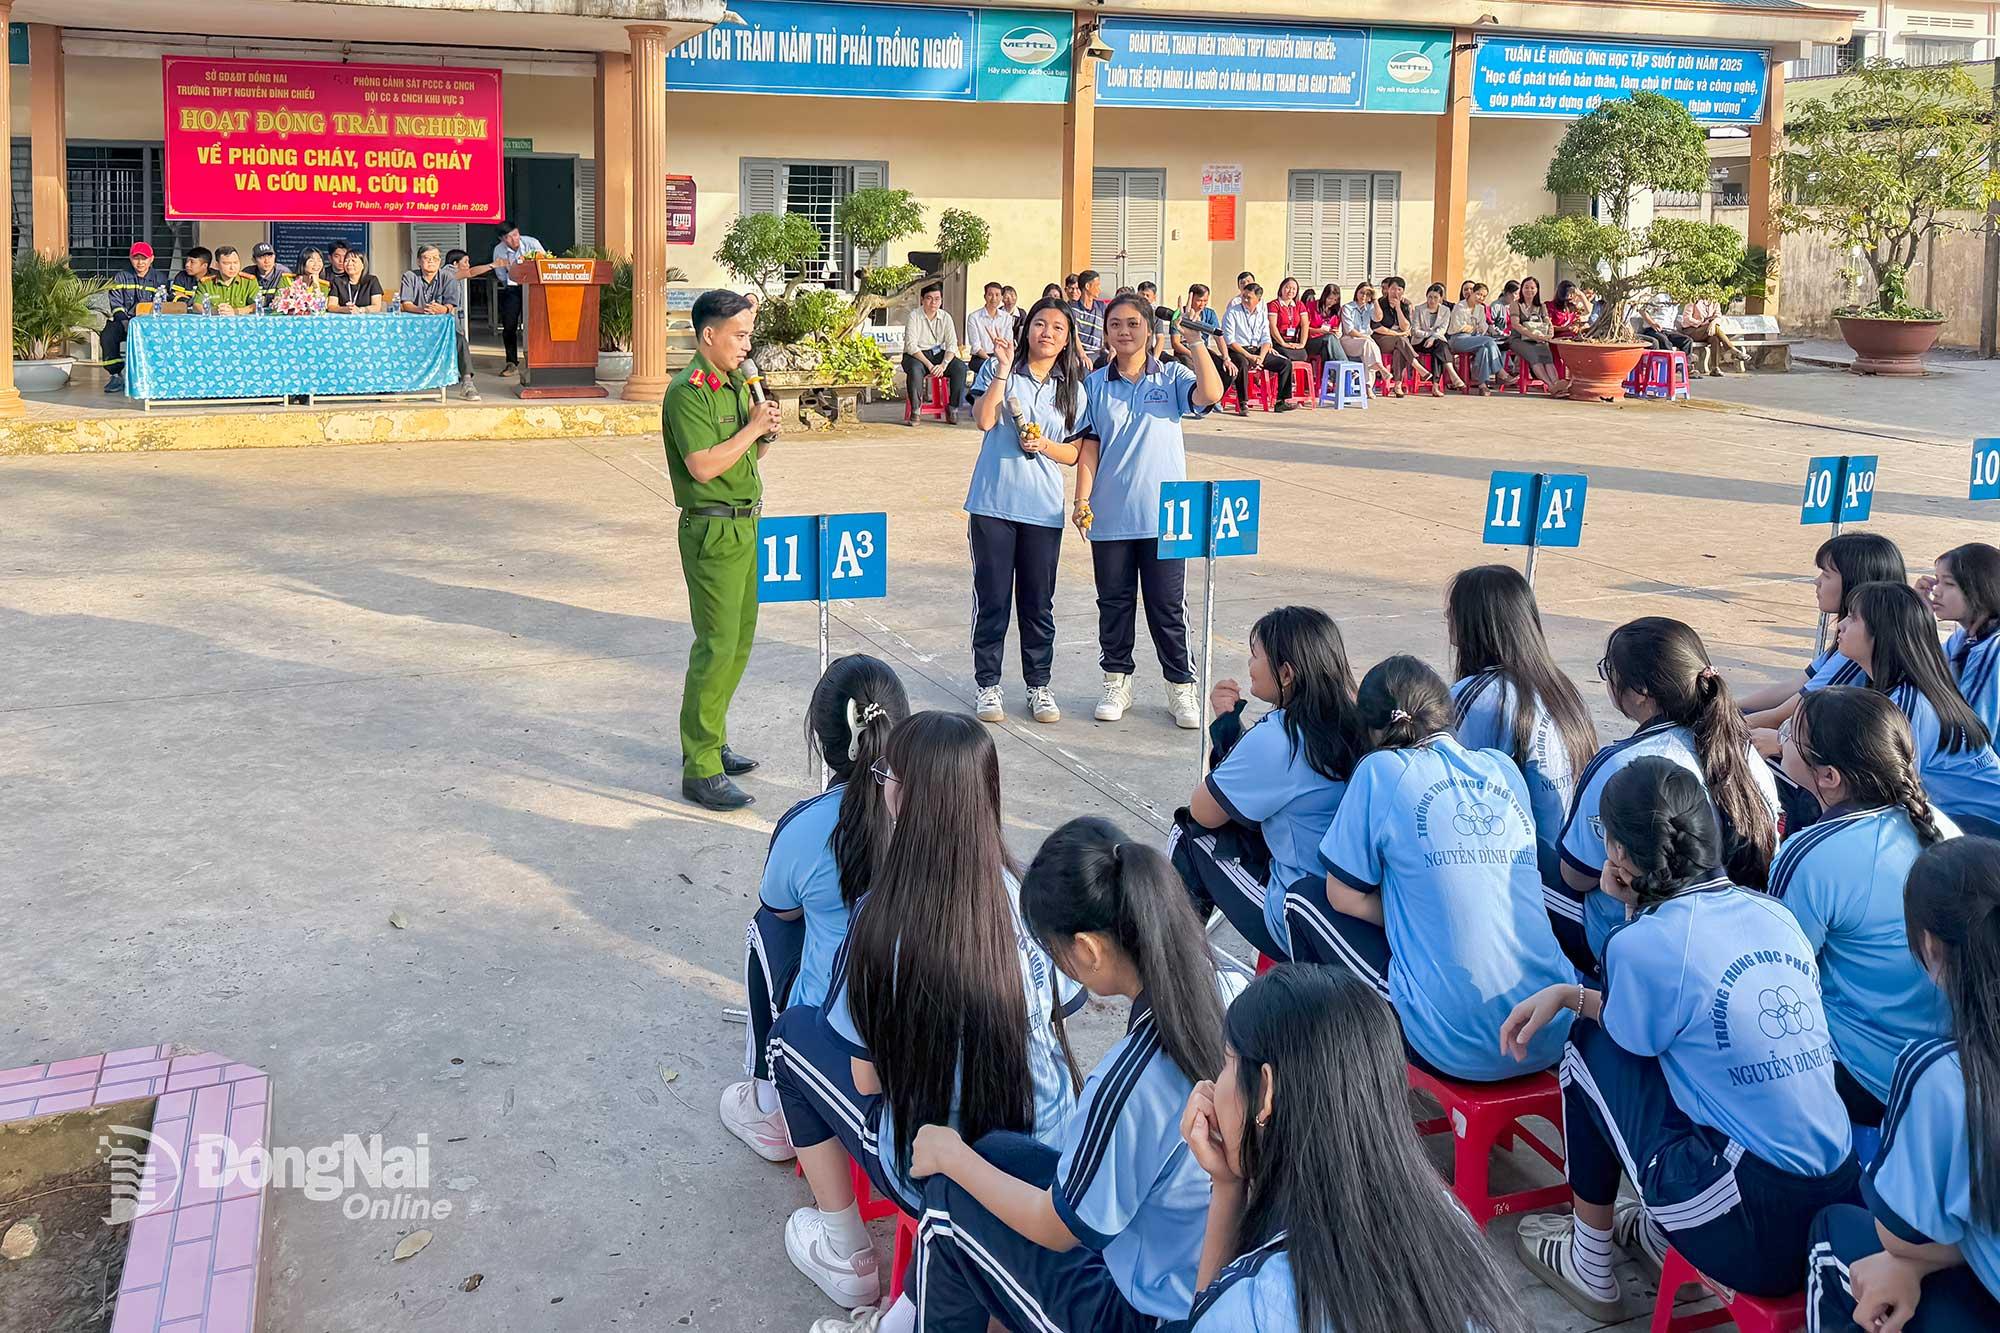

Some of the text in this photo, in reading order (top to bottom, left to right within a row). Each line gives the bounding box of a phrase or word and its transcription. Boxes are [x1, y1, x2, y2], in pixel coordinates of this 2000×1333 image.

[735, 24, 775, 62] TRĂM
[779, 25, 812, 64] NĂM
[816, 27, 836, 65] THÌ
[840, 25, 872, 66] PHẢI
[876, 26, 920, 68] TRỒNG
[922, 32, 964, 70] NGƯỜI
[1129, 30, 1150, 53] ĐOÀN
[1152, 31, 1170, 56] VIÊN,
[1172, 36, 1196, 55] THANH
[1198, 33, 1217, 56] NIÊN
[1217, 33, 1245, 56] TRƯỜNG
[1247, 38, 1265, 58] THPT
[1265, 34, 1294, 58] NGUYỄN
[1295, 37, 1313, 59] ĐÌNH
[1505, 44, 1743, 72] TUẦN LỄ HƯỞNG ỨNG HỌC TẬP SUỐT ĐỜI NĂM 2025
[205, 69, 216, 81] SỞ
[248, 70, 270, 83] ĐỒNG
[273, 74, 288, 84] NAI
[354, 75, 475, 91] PHÒNG CẢNH SÁT PCCC & CNCH
[1144, 66, 1161, 92] HIỆN
[1162, 66, 1183, 89] MÌNH
[1184, 67, 1194, 89] LÀ
[1195, 67, 1218, 90] NGƯỜI
[1219, 68, 1229, 90] CÓ
[1231, 69, 1246, 91] VĂN
[1246, 69, 1261, 91] HÓA
[1262, 73, 1276, 91] KHI
[1276, 74, 1296, 92] THAM
[1297, 75, 1309, 92] GIA
[1311, 75, 1327, 93] GIAO
[1523, 72, 1546, 86] phát
[1548, 70, 1571, 86] triển
[1574, 72, 1591, 87] bản
[1594, 74, 1618, 90] thân,
[1621, 75, 1639, 89] làm
[1641, 76, 1659, 90] chủ
[1674, 78, 1694, 90] thức
[1696, 79, 1707, 91] và
[1710, 80, 1731, 93] công
[1734, 80, 1758, 95] nghệ,
[177, 84, 210, 96] TRƯỜNG
[212, 87, 232, 97] THPT
[234, 86, 267, 98] NGUYỄN
[270, 87, 288, 98] ĐÌNH
[365, 92, 464, 106] ĐỘI CC & CNCH KHU VỰC 3
[1490, 92, 1508, 107] góp
[1511, 92, 1536, 108] phần
[1539, 96, 1557, 109] xây
[1559, 96, 1583, 111] dựng
[1688, 100, 1711, 116] thịnh
[180, 106, 487, 144] HOẠT ĐỘNG TRẢI NGHIỆM
[197, 142, 472, 170] VỀ PHÒNG CHÁY, CHỮA CHÁY
[234, 170, 439, 198] VÀ CỨU NẠN, CỨU HỘ
[332, 200, 352, 212] Long
[355, 200, 382, 210] Thành,
[384, 202, 404, 212] ngày
[406, 202, 415, 210] 17
[416, 202, 438, 212] tháng
[452, 204, 468, 212] năm
[470, 204, 488, 212] 2026
[1973, 450, 2000, 486] 10
[1804, 469, 1832, 508] 10
[1162, 499, 1193, 541] 11
[1490, 486, 1521, 527] 11
[764, 534, 802, 582] 11
[1414, 792, 1434, 839] TRƯỜNG
[1424, 842, 1476, 868] NGUYỄN
[1480, 845, 1508, 866] ĐÌNH
[1708, 988, 1731, 1050] TRƯỜNG
[1720, 954, 1756, 989] TRUNG
[1754, 950, 1782, 966] HỌC
[1728, 1050, 1794, 1086] NGUYỄN
[1793, 1048, 1821, 1072] ĐÌNH
[858, 1256, 874, 1268] NIKE
